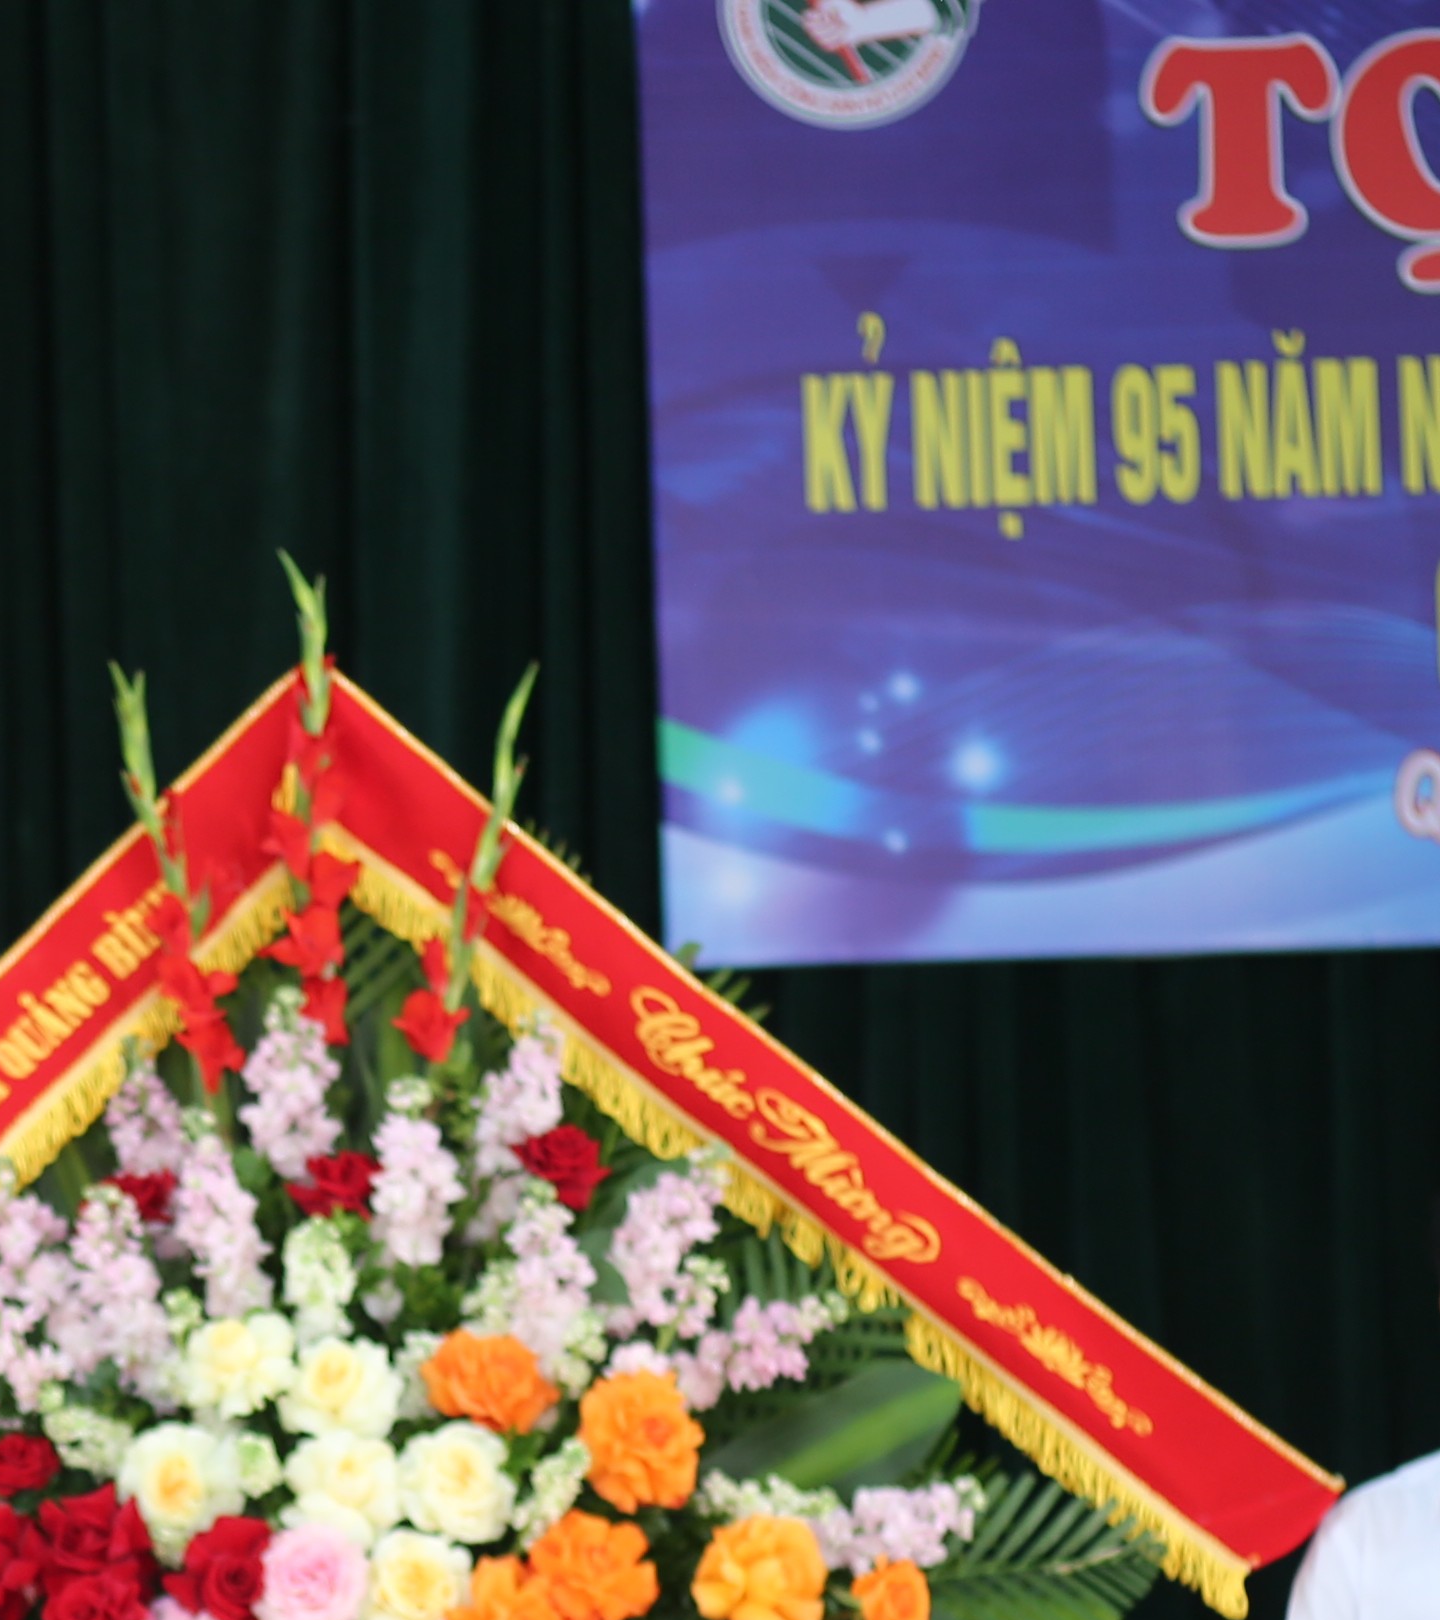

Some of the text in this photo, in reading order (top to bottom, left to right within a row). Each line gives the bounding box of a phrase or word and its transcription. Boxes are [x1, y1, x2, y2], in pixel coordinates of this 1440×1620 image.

[801, 312, 893, 513] KỶ
[911, 338, 1097, 540] NIỆM
[1111, 364, 1201, 504] 95
[1215, 329, 1382, 500] NĂM
[630, 984, 755, 1119] Chúc
